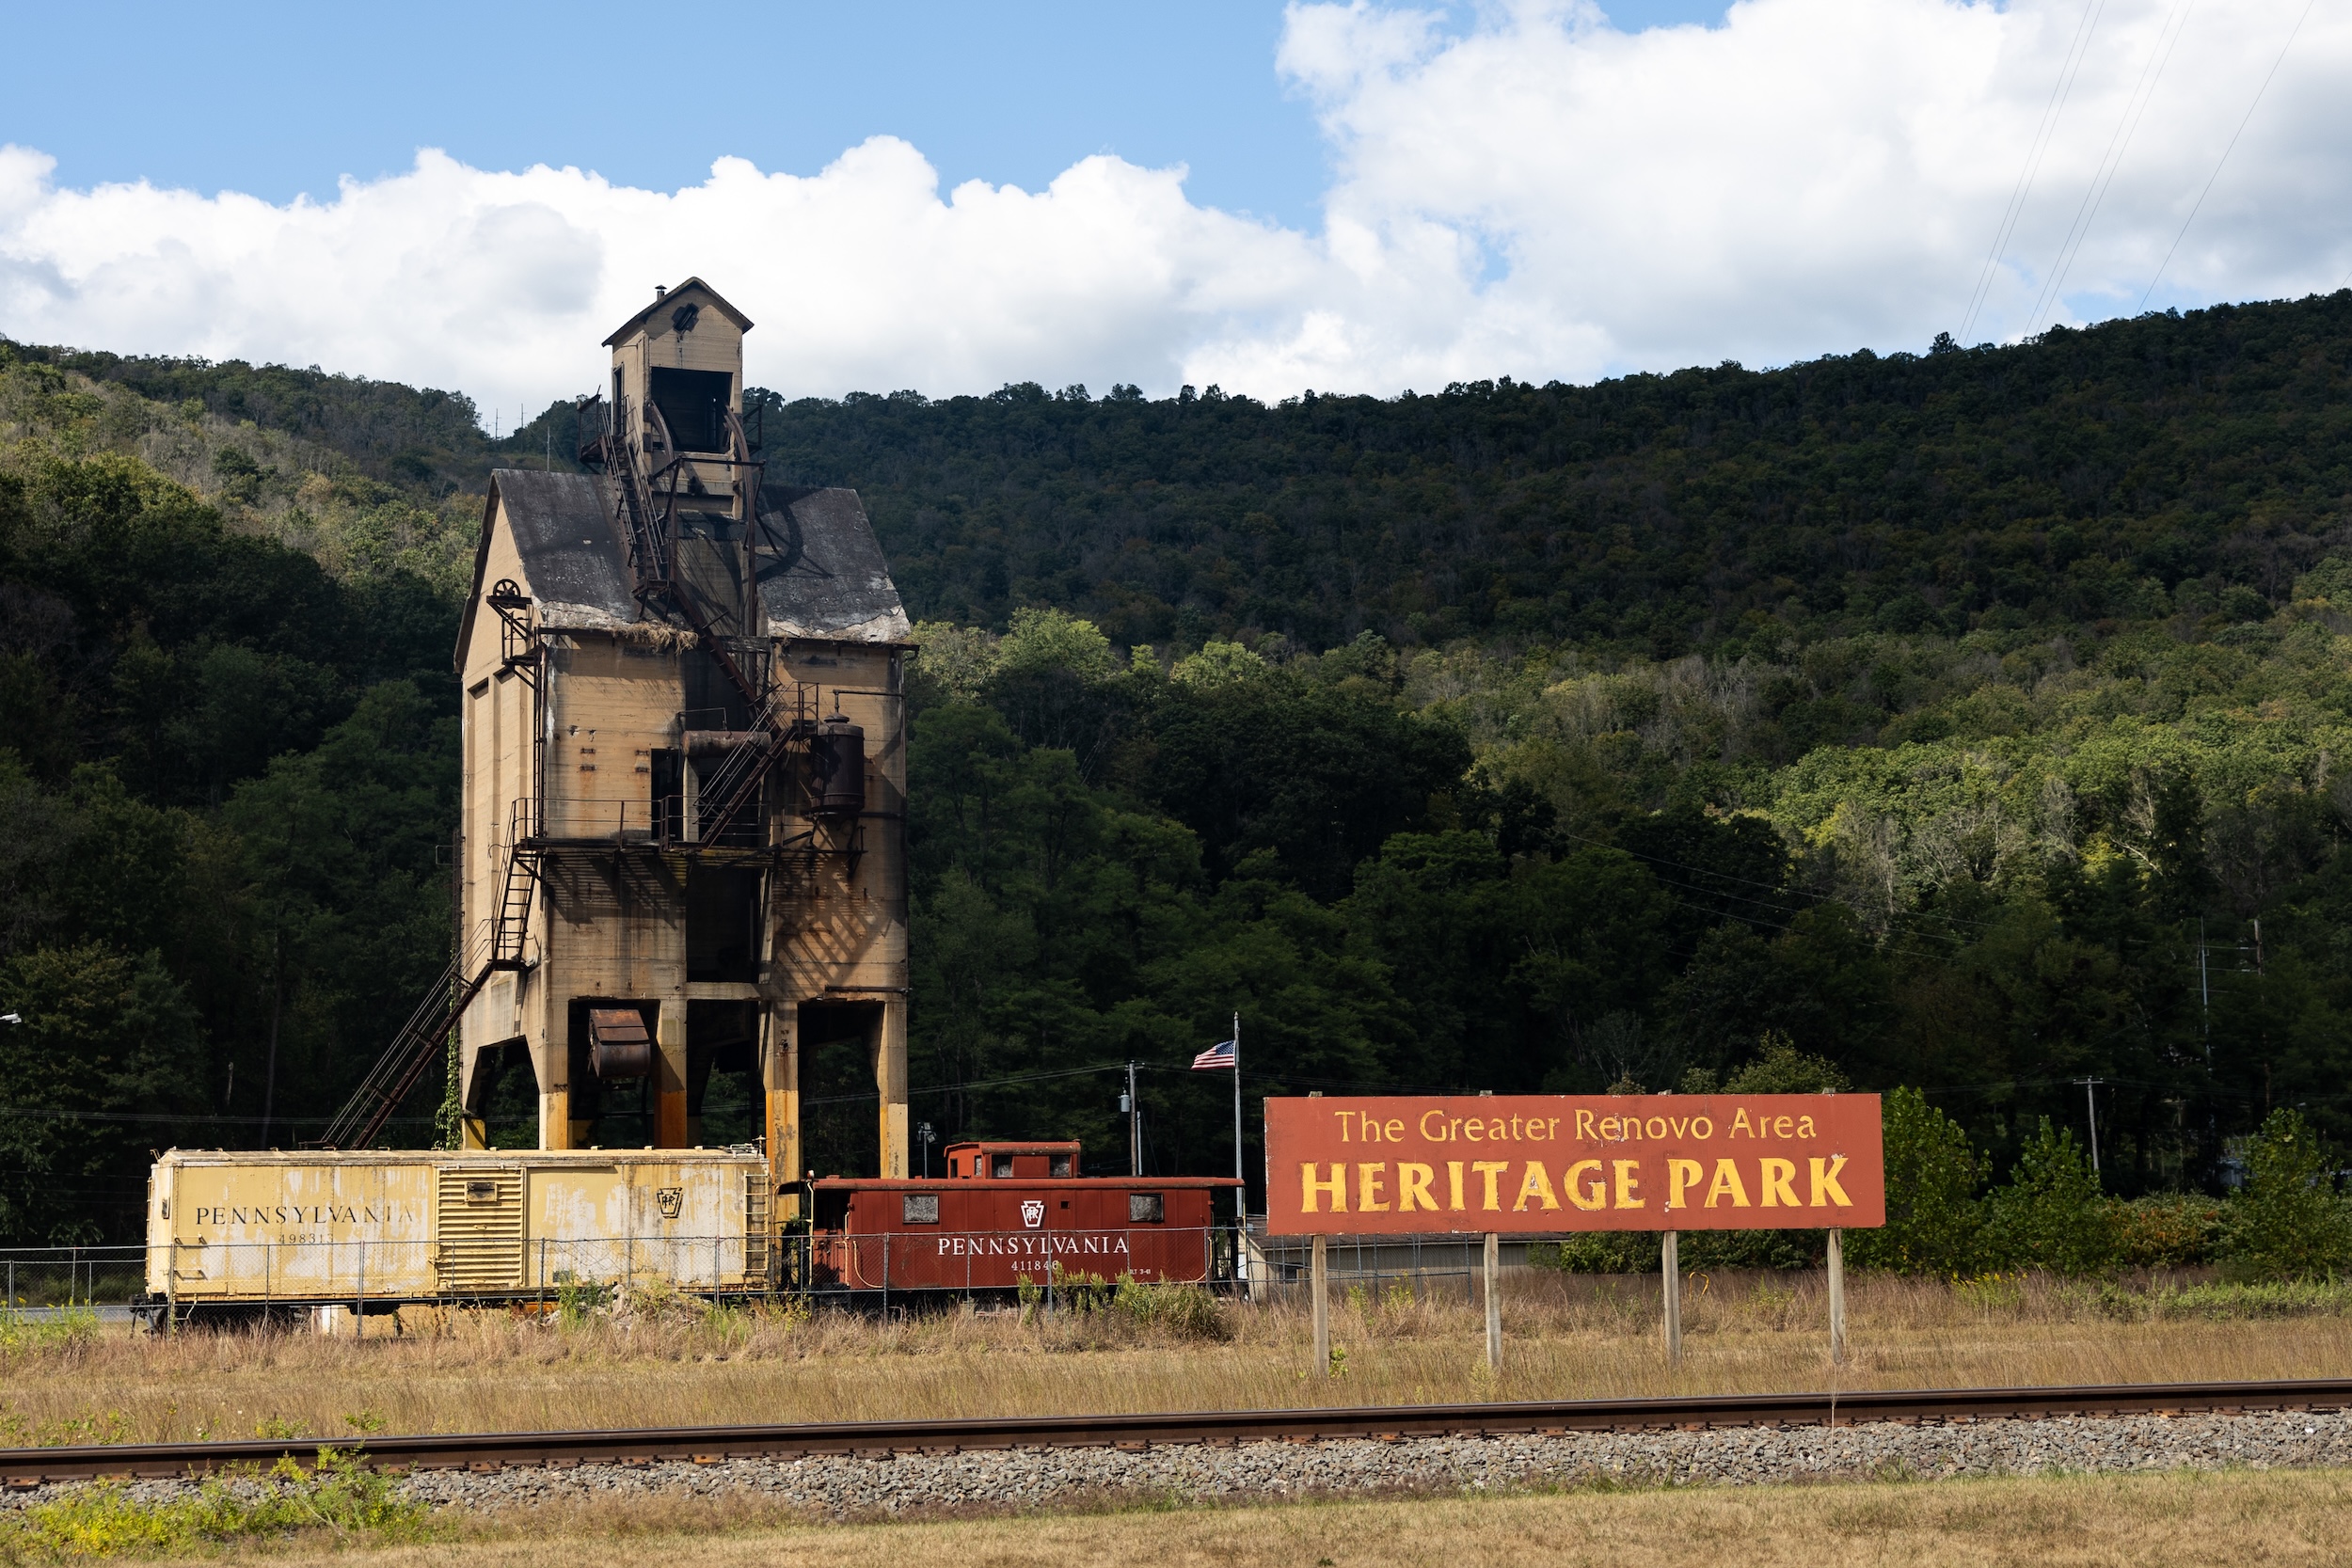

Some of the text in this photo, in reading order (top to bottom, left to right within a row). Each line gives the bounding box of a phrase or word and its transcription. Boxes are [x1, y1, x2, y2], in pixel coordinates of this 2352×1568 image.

[1335, 1106, 1818, 1144] The Greater Renovo Area
[1299, 1155, 1854, 1213] HERITAGE PARK
[196, 1206, 413, 1225] PENNSYLVANIA
[937, 1235, 1128, 1256] PENNSYLVANIA
[1010, 1259, 1059, 1272] 411846
